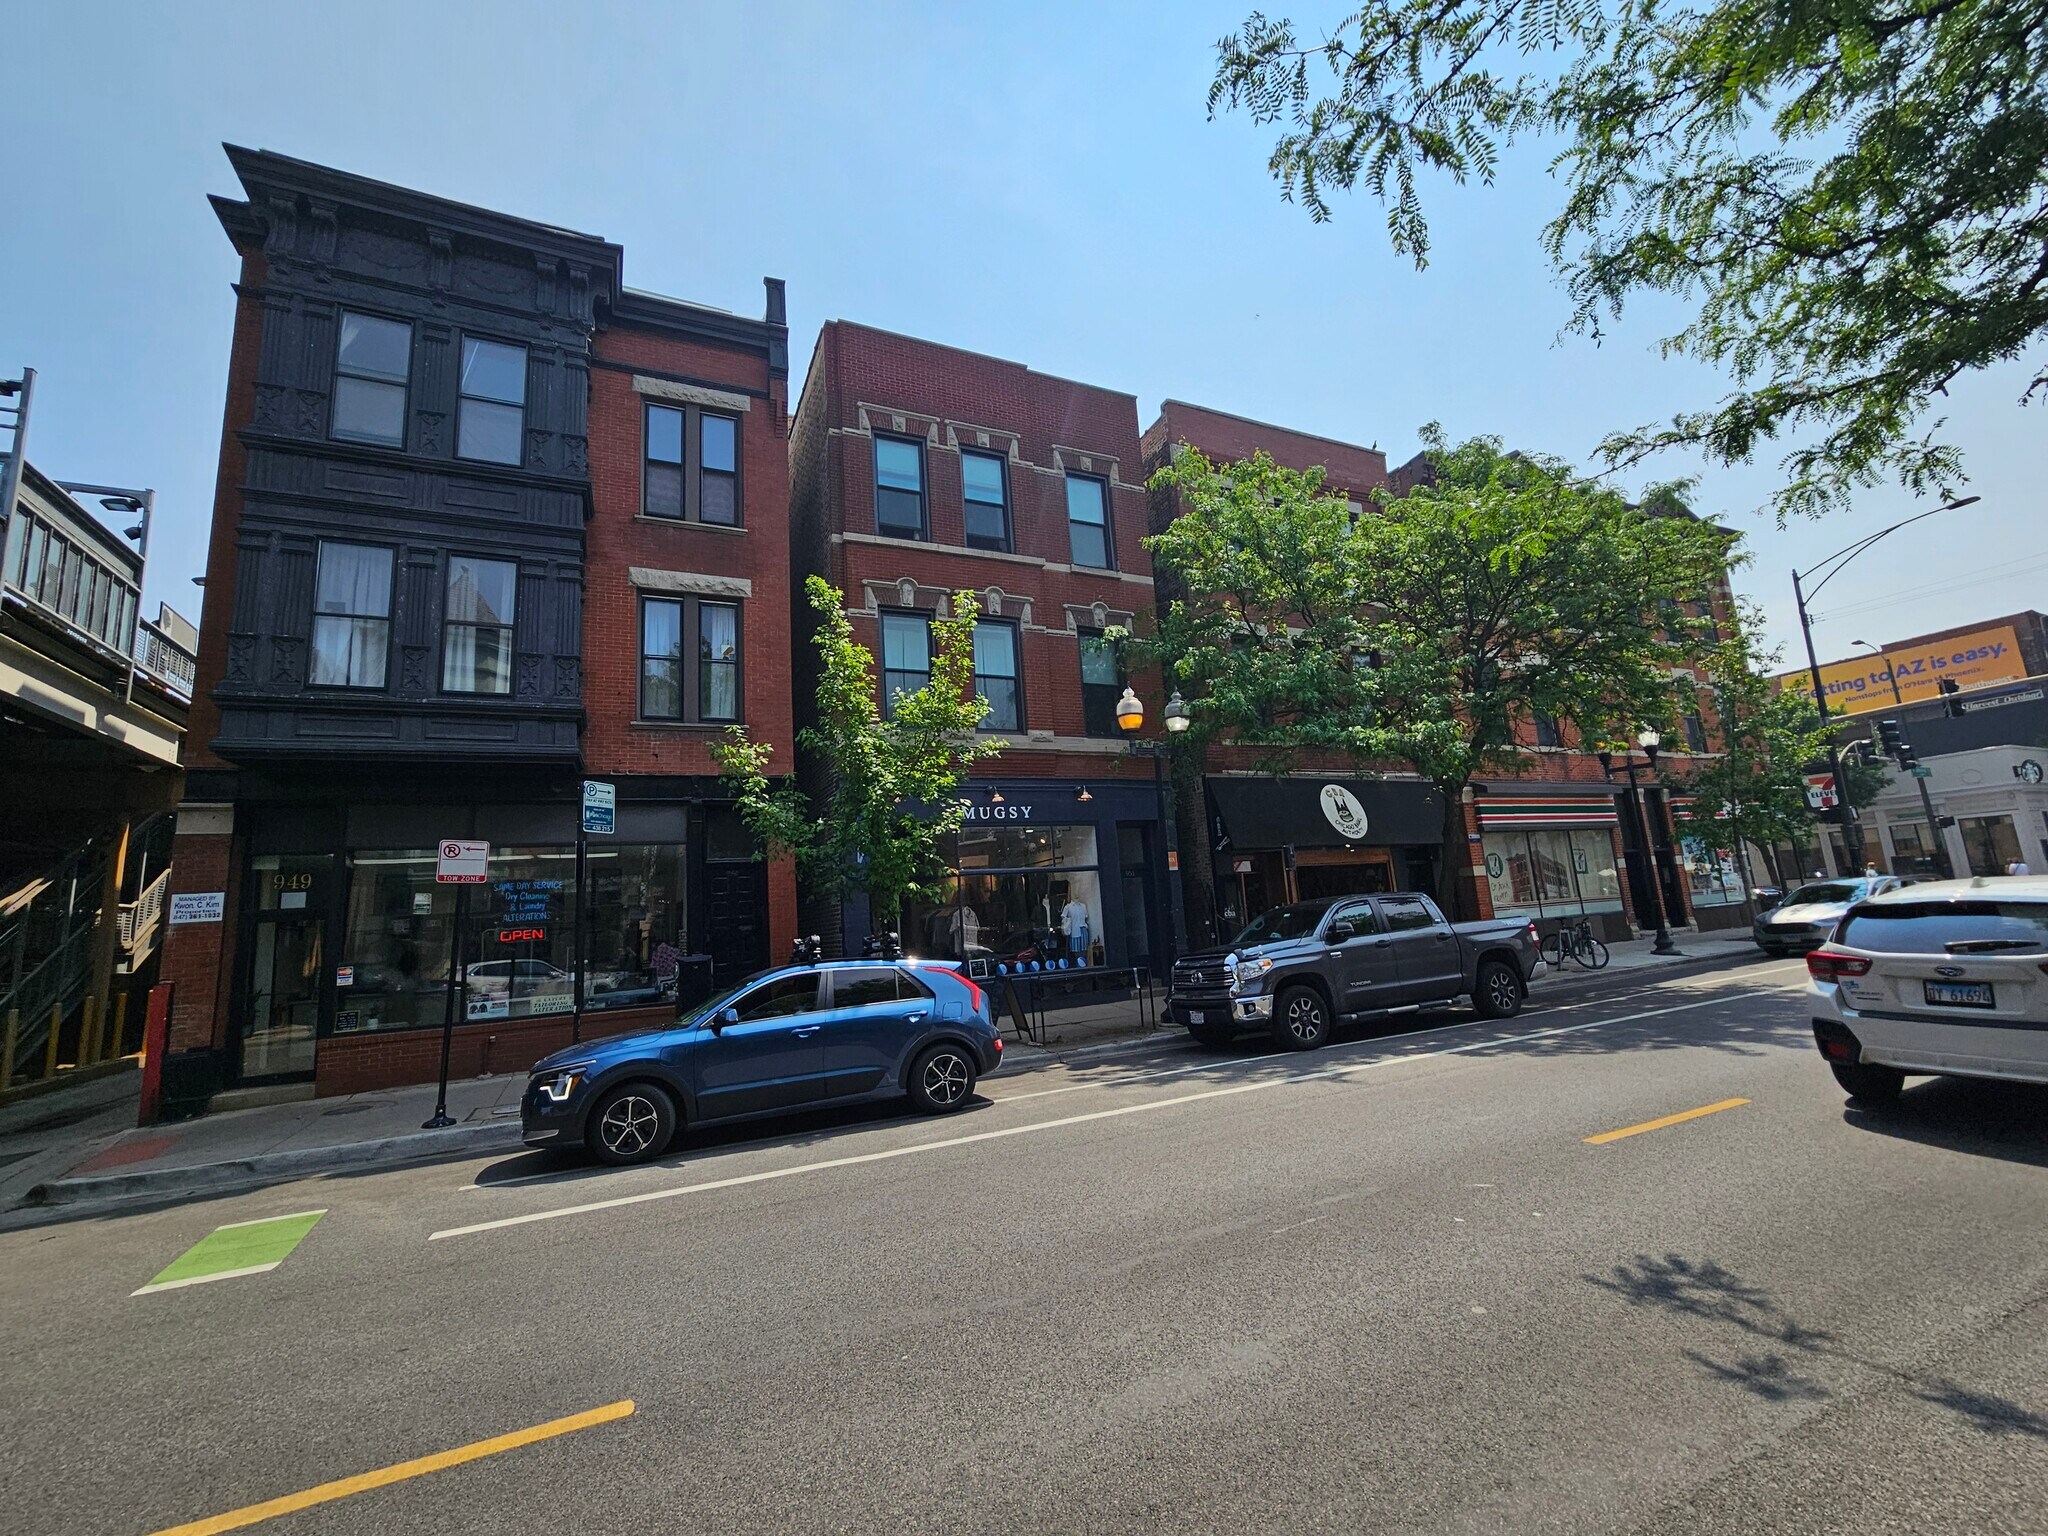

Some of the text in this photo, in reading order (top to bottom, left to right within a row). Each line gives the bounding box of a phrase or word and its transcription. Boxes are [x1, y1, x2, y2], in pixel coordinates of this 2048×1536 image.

[1797, 642, 2008, 700] Getting to AZ is easy.
[1845, 690, 1883, 703] Nonstops
[1904, 677, 1933, 689] O'Hare
[1811, 790, 1835, 798] ELEVE
[961, 805, 1032, 820] MUGSY
[273, 873, 312, 890] 949
[493, 881, 562, 892] SAME DAY SERVICE
[505, 891, 518, 902] Dry
[510, 904, 516, 912] &
[503, 911, 551, 922] ALTERATIONS
[500, 929, 545, 942] OPEN
